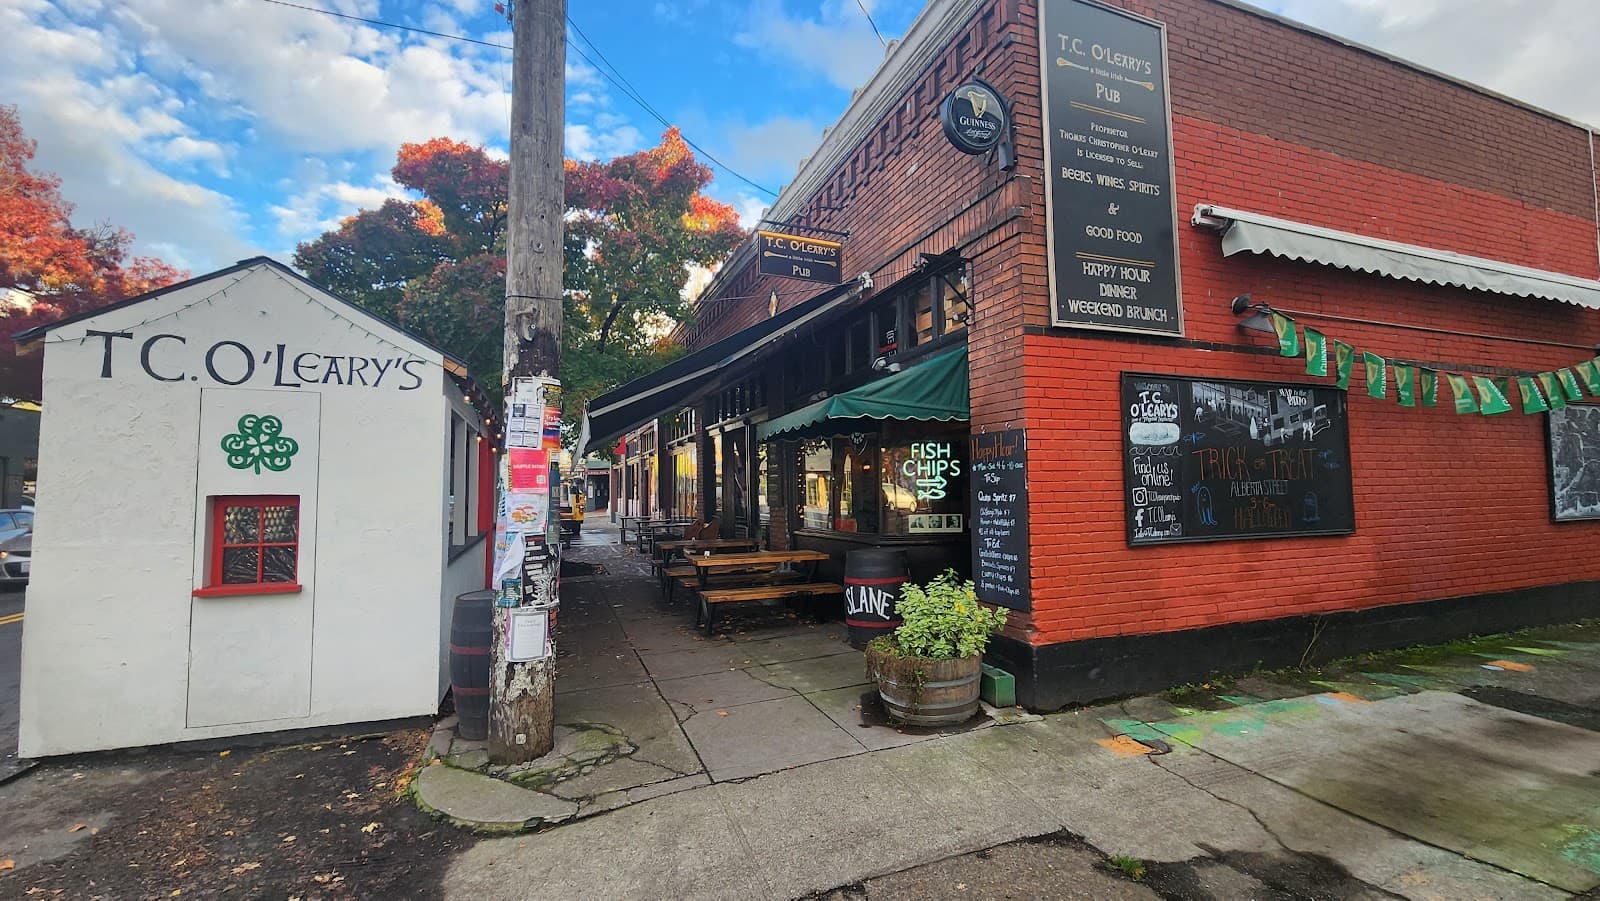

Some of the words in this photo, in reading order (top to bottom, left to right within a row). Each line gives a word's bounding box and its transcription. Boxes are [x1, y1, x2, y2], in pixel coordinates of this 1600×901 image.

[1058, 33, 1085, 56] T.C.
[1091, 44, 1152, 75] O'LEARY'S
[960, 116, 996, 130] GUINNESS
[1062, 166, 1093, 184] BEERS,
[1096, 173, 1126, 190] WINES,
[1129, 180, 1160, 196] SPIRITS
[1108, 202, 1120, 216] &
[1086, 224, 1113, 240] GOOD
[1116, 229, 1143, 244] FOOD
[765, 236, 786, 249] T.C.
[790, 240, 836, 257] O'LEARY'S
[1082, 261, 1117, 278] HAPPY
[1120, 266, 1150, 282] HOUR
[1099, 282, 1137, 300] DINNER
[1067, 298, 1123, 317] WEEKEND
[1126, 305, 1168, 322] BRUNCH
[205, 340, 428, 391] O'LEARY'S
[911, 442, 951, 459] FISH
[902, 459, 961, 477] CHIPS
[1133, 456, 1152, 475] Find
[1156, 462, 1169, 474] us
[1192, 446, 1250, 481] TRICK
[1265, 446, 1317, 480] TREAT
[1230, 481, 1263, 498] ALBERTA
[845, 586, 894, 620] SLANE
